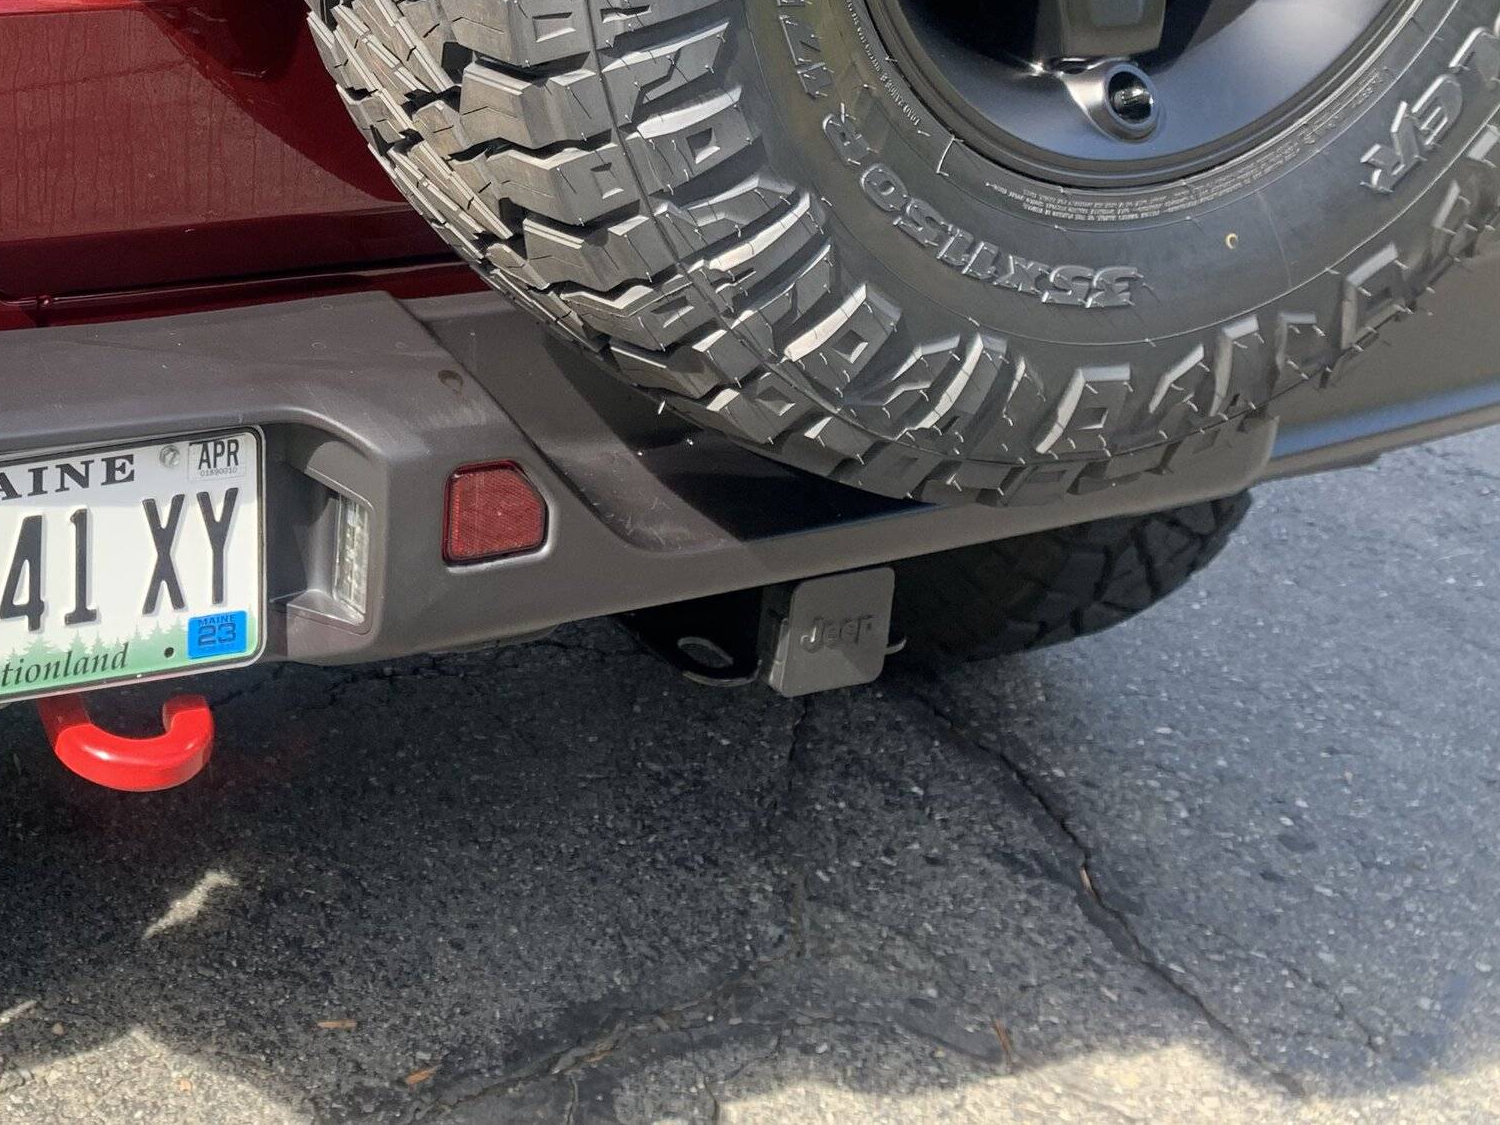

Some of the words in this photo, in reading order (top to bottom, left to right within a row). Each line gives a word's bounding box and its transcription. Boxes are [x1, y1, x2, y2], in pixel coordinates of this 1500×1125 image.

[198, 438, 240, 470] APR
[141, 486, 241, 616] XY
[197, 614, 236, 627] MAINE
[198, 622, 236, 646] 23
[801, 614, 876, 654] Jeep
